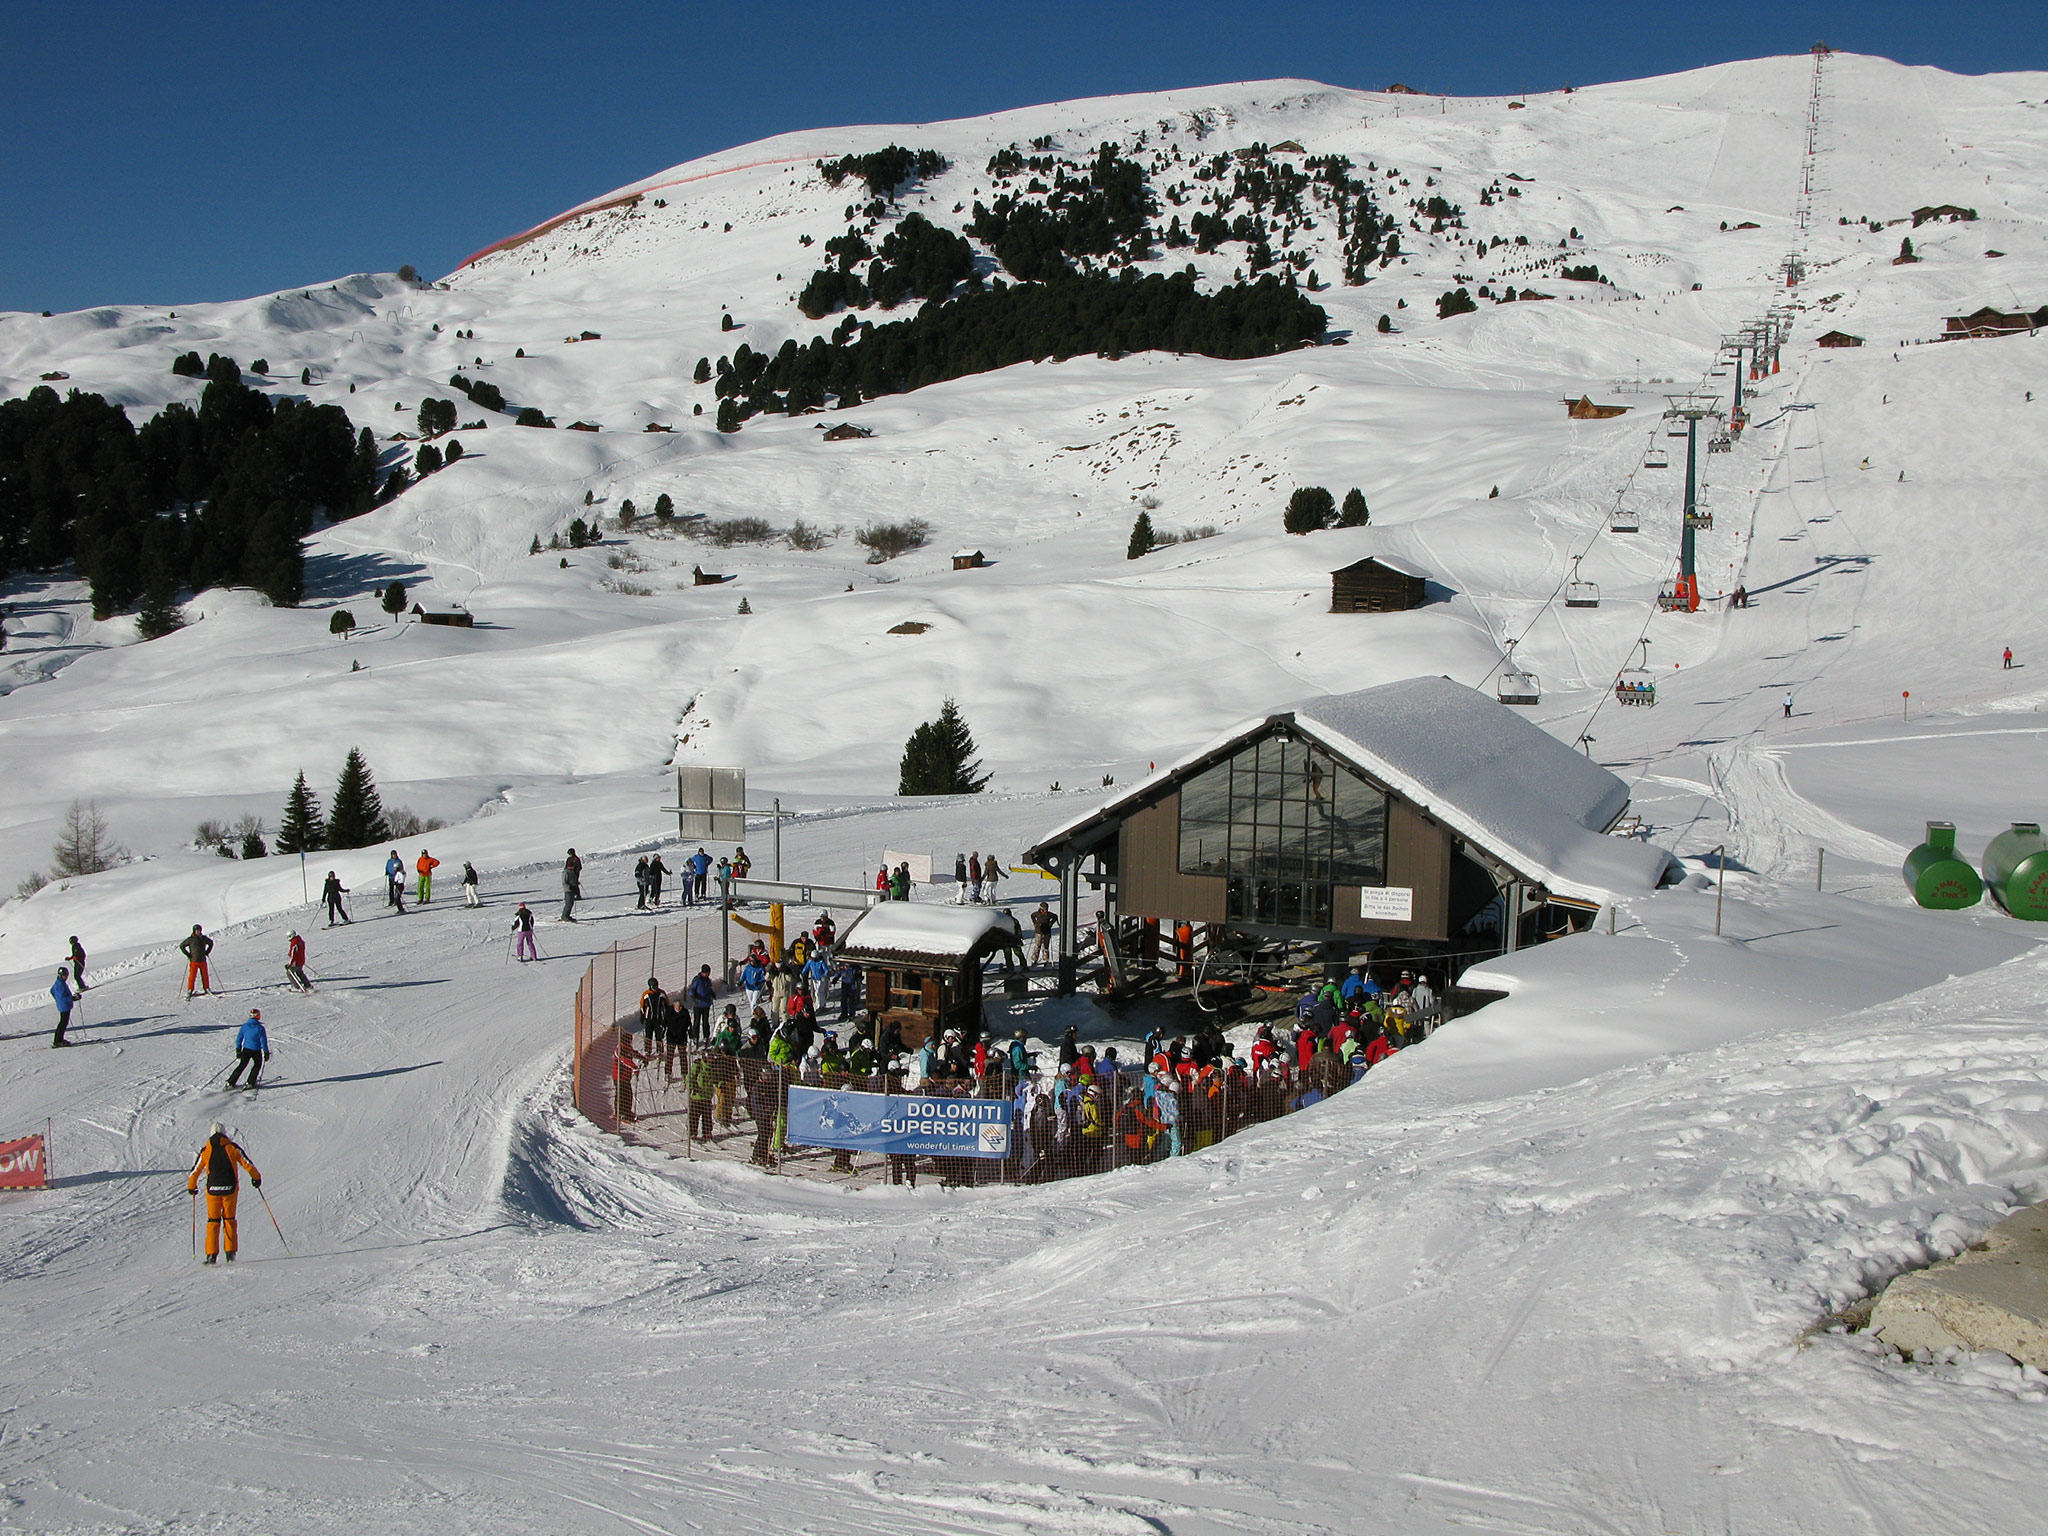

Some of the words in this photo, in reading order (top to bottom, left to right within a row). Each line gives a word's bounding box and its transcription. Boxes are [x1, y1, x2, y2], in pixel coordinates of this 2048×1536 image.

[907, 1102, 1002, 1120] DOLOMITI
[880, 1119, 976, 1136] SUPERSKI
[907, 1142, 950, 1151] wonderful
[952, 1143, 976, 1152] times
